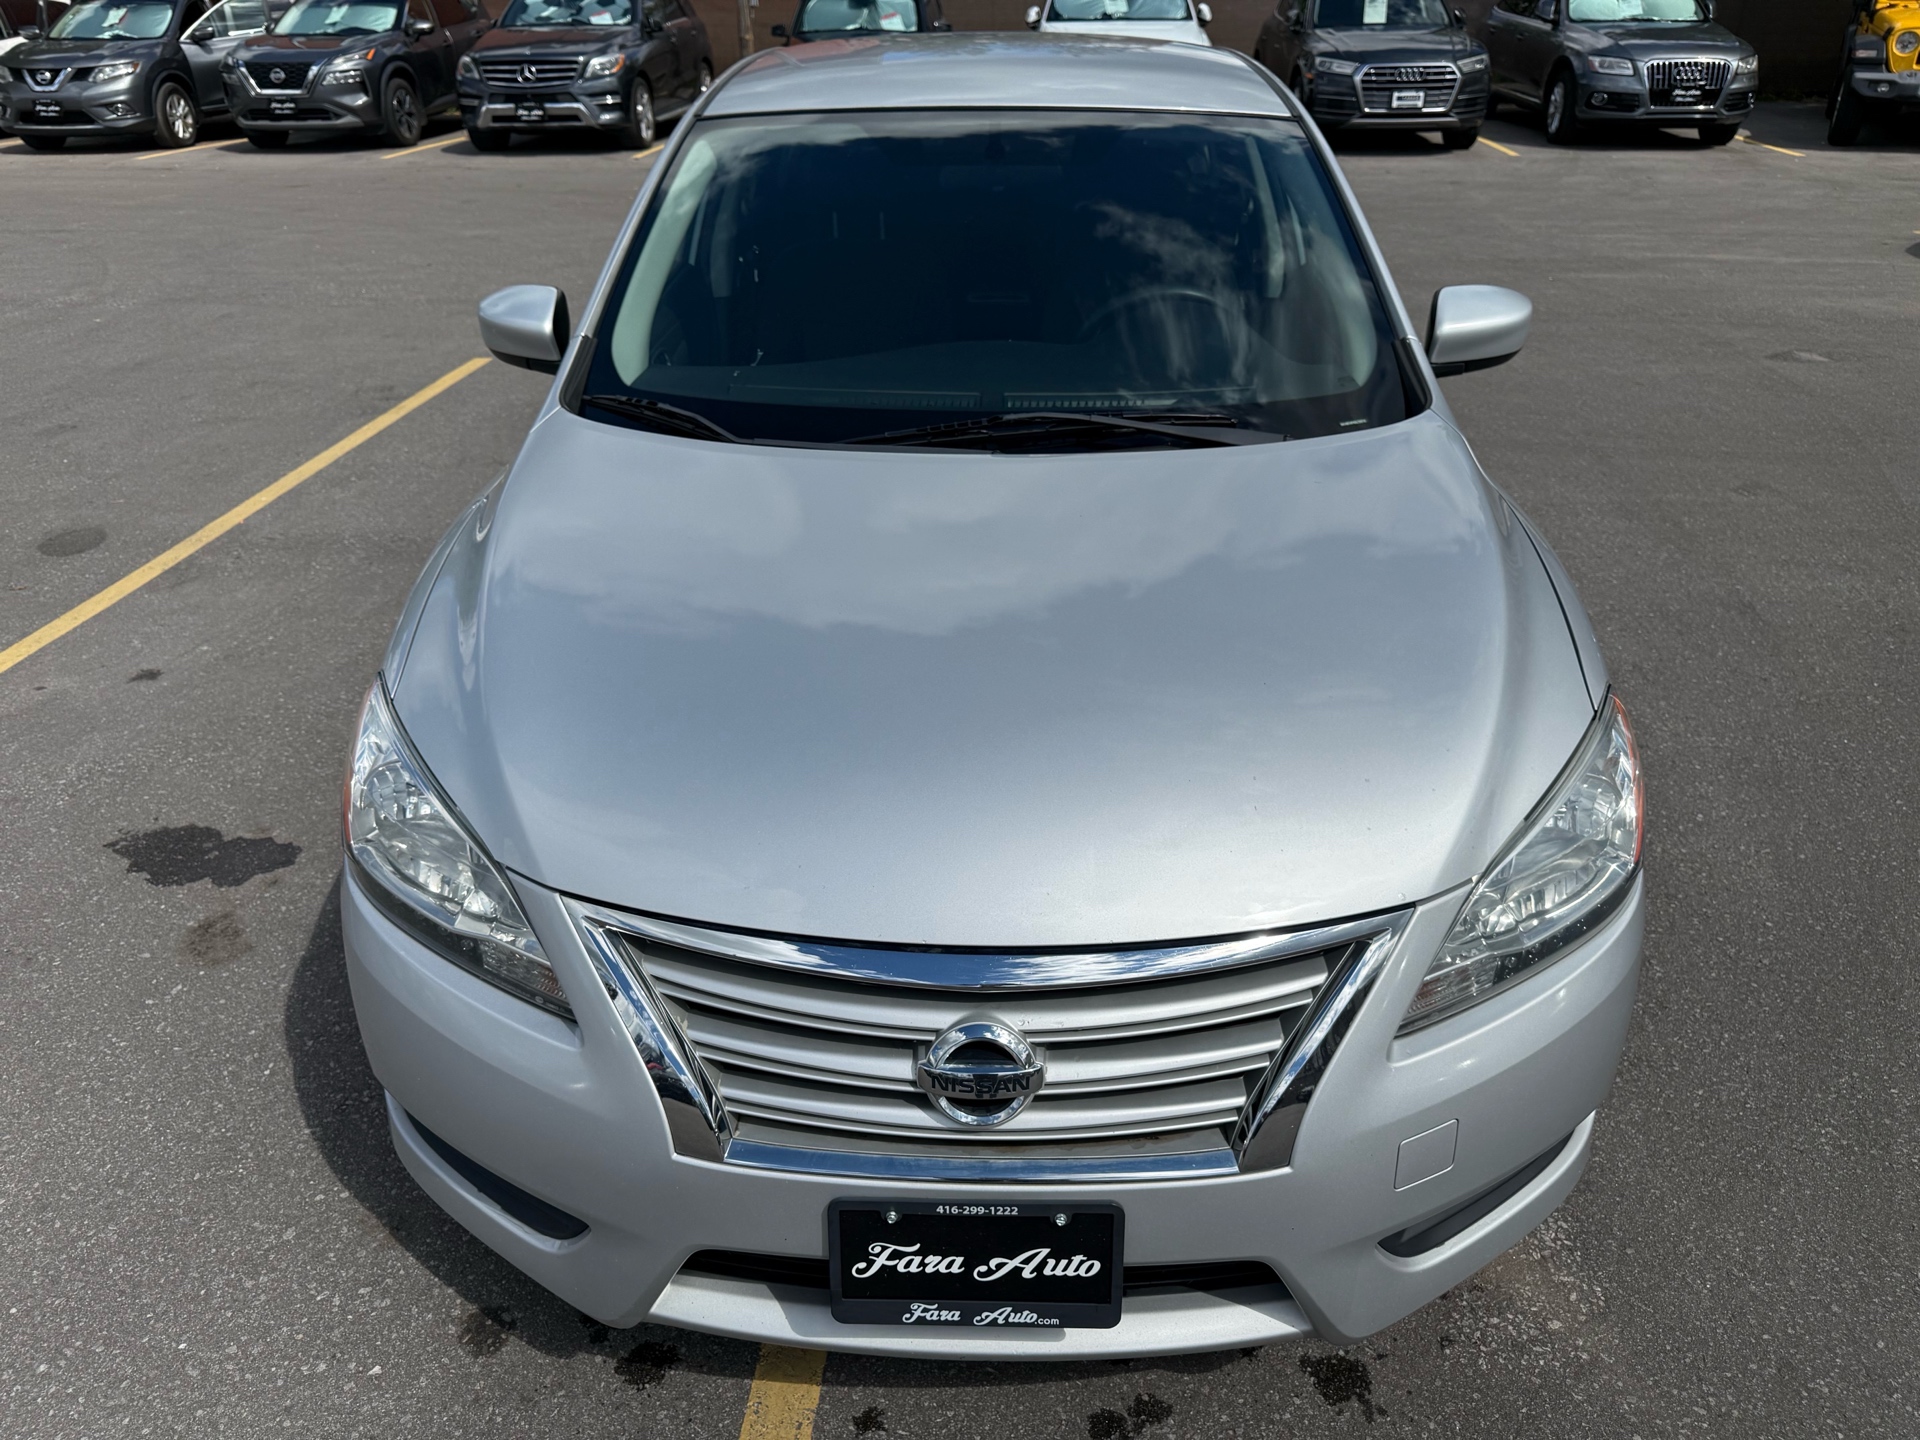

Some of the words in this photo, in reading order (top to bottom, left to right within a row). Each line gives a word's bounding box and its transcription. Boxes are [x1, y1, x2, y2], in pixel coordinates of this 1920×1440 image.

[931, 1075, 1030, 1094] NISSAN
[936, 1205, 1019, 1216] 416-299-1222
[851, 1242, 965, 1278] Fara
[973, 1248, 1101, 1282] Auto
[902, 1302, 961, 1323] Fara
[973, 1306, 1059, 1326] Auto.com
